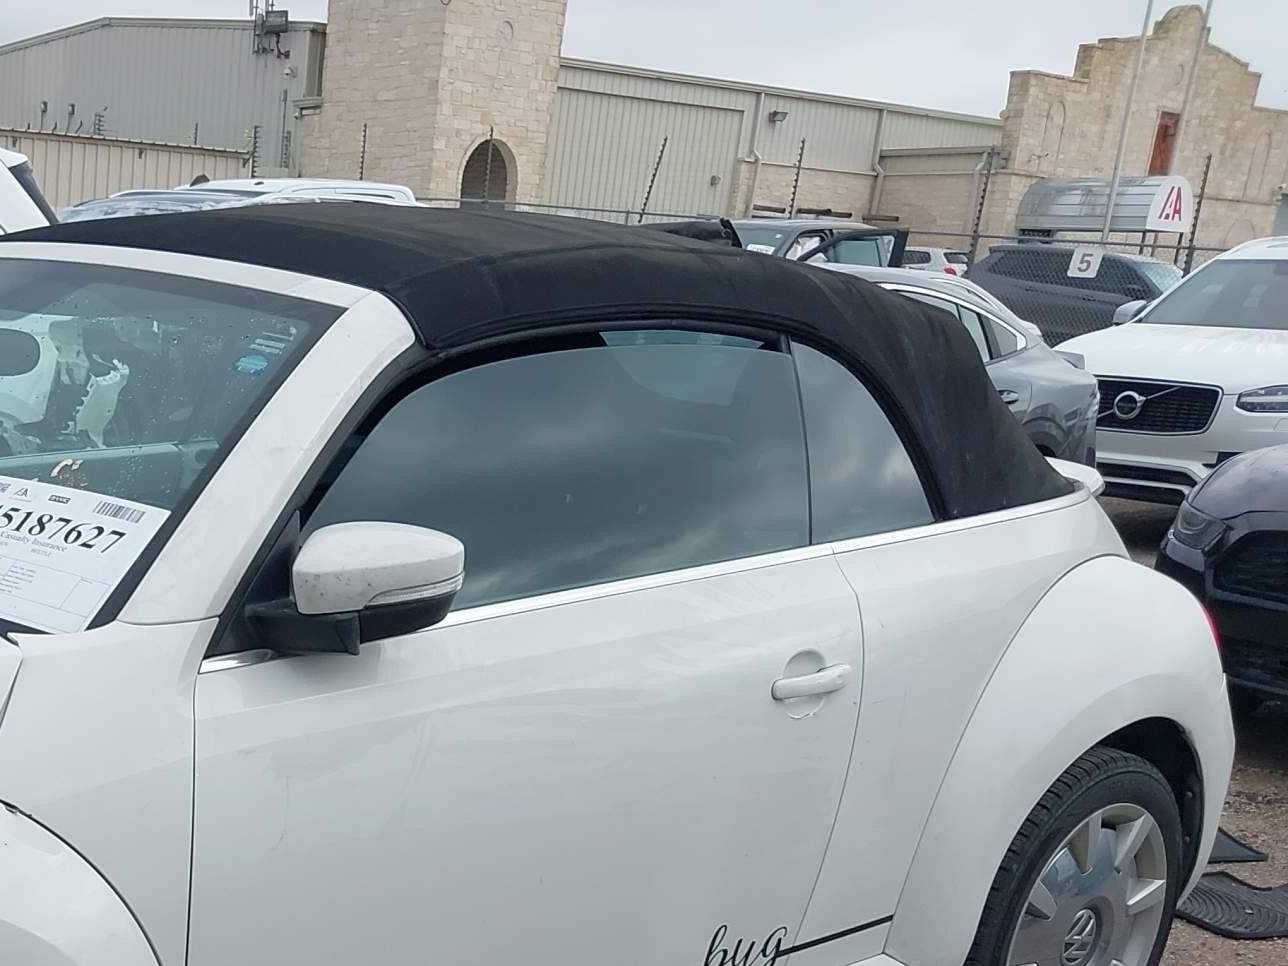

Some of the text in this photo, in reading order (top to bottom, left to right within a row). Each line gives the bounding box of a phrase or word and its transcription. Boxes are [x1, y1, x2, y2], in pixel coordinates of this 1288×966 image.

[1077, 253, 1094, 273] 5
[0, 531, 30, 544] Casualty
[31, 538, 67, 552] Insurance
